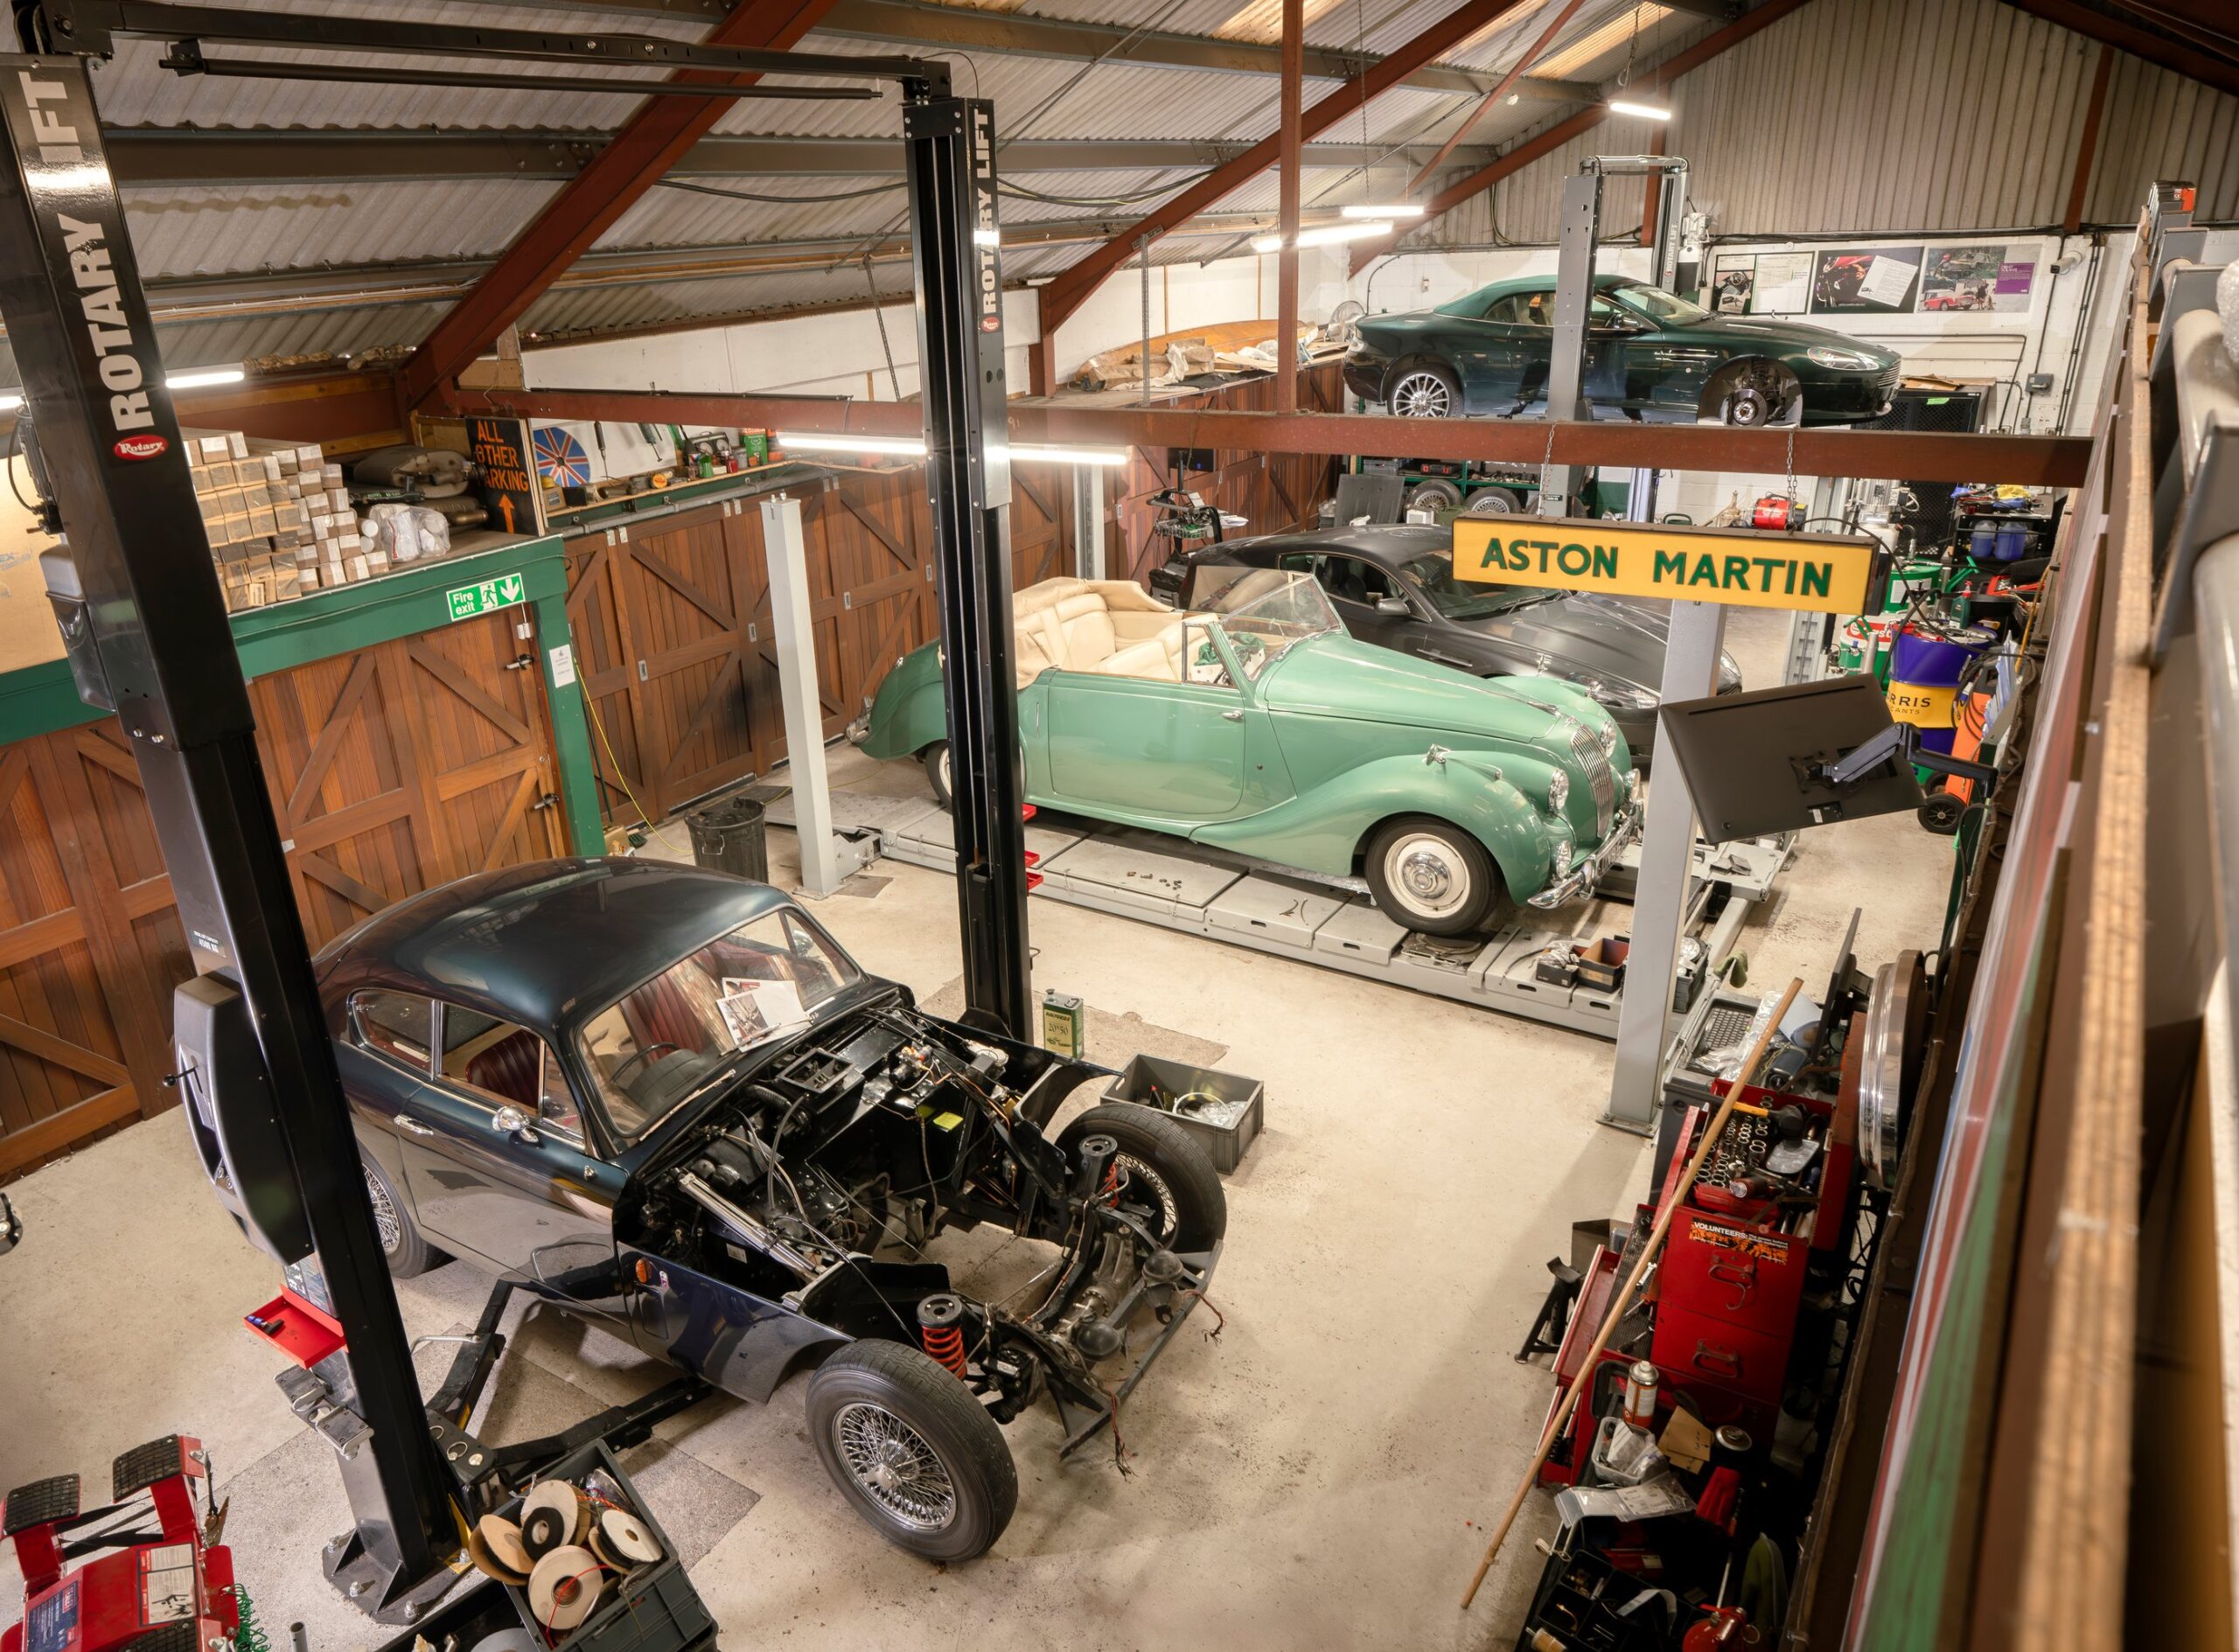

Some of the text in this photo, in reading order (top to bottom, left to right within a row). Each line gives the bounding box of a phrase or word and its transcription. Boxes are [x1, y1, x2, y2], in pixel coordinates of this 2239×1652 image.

[973, 108, 991, 178] LIFT
[17, 71, 155, 431] ROTARY IFT
[1666, 242, 1677, 271] ROTARY
[478, 420, 504, 443] ALL
[119, 441, 164, 456] Rotary
[476, 443, 520, 468] OTHER
[484, 470, 529, 492] ARKING
[1480, 537, 1833, 598] ASTON MARTIN
[453, 591, 473, 605] Fire
[456, 603, 475, 615] exit
[1887, 693, 1931, 708] RRIS
[1693, 1221, 1748, 1240] VOLUNTEERS:
